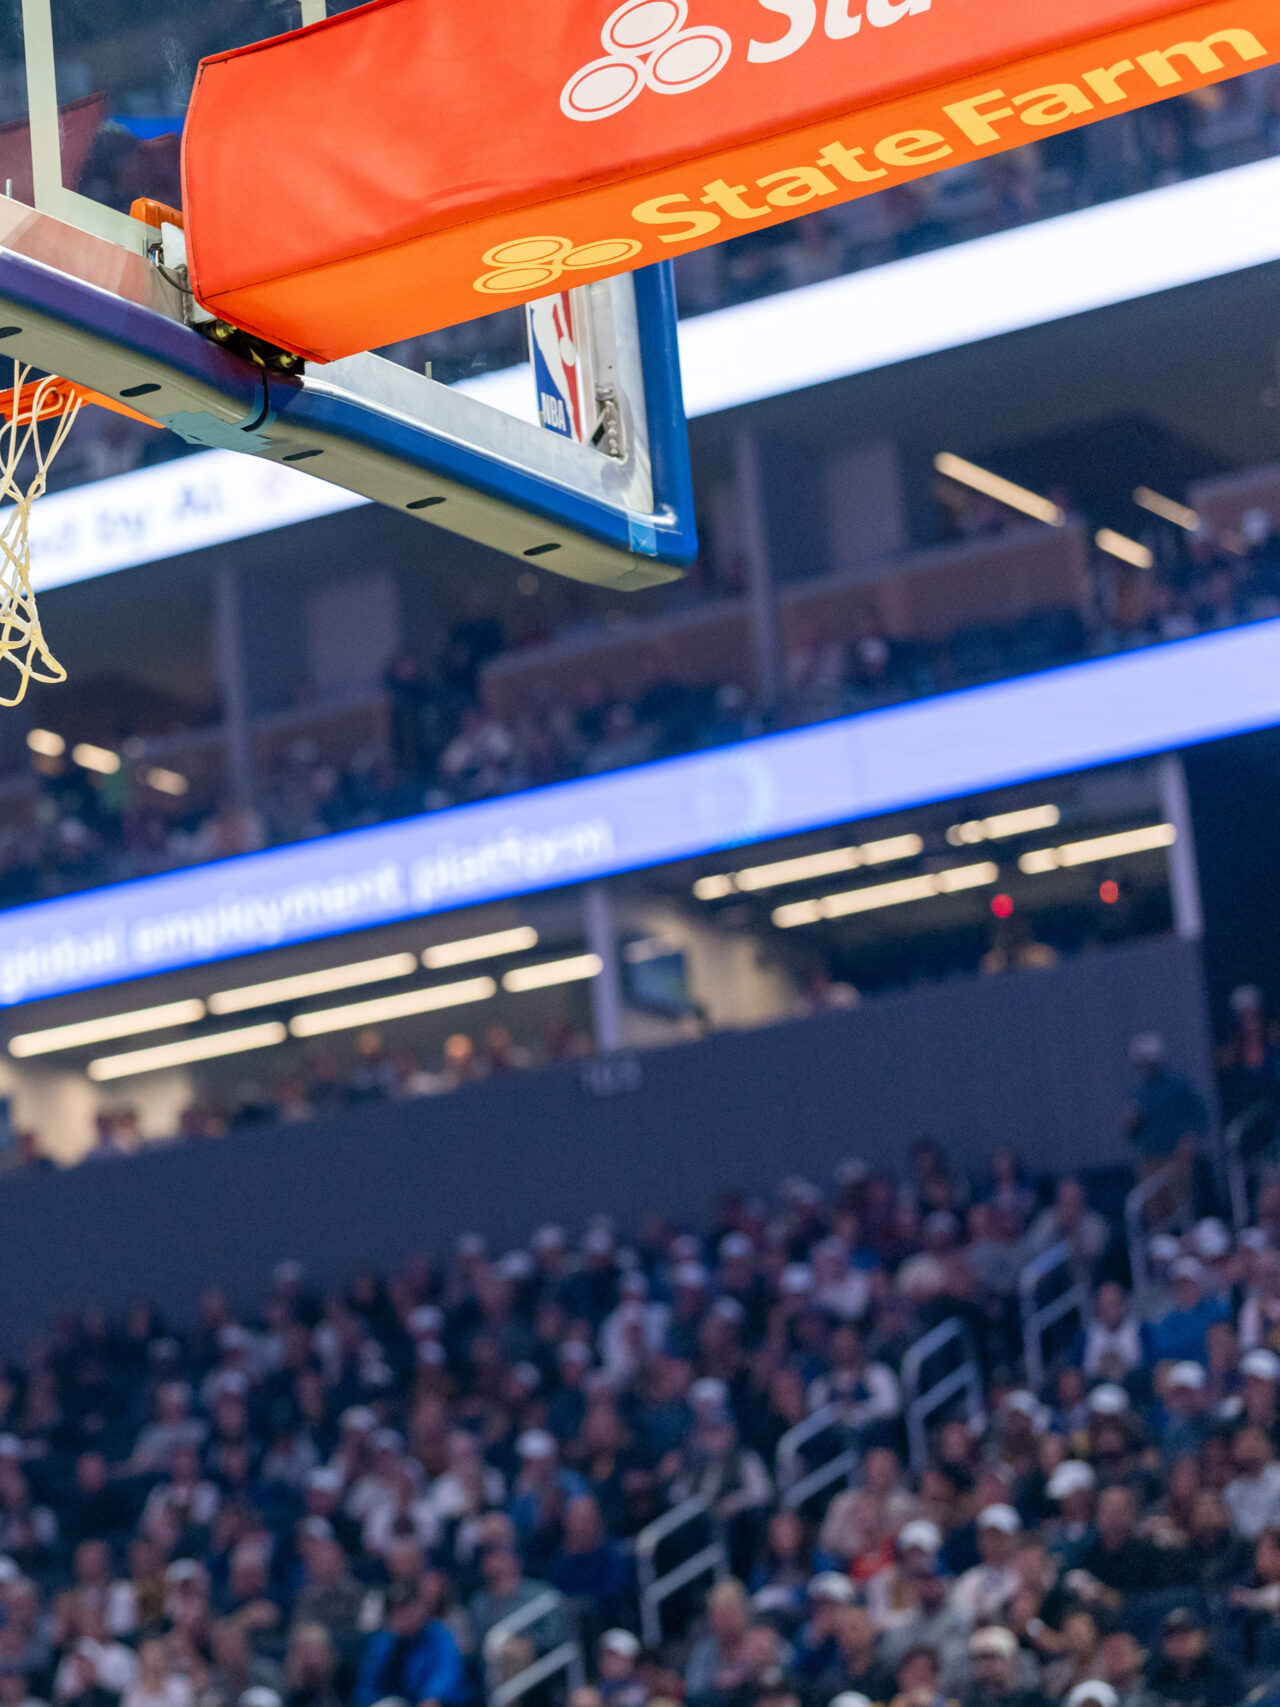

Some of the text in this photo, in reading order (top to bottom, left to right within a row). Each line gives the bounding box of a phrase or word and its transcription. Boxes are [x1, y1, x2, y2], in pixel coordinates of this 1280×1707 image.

[540, 391, 568, 432] NBA
[134, 864, 404, 952] employment
[412, 820, 612, 902] platform
